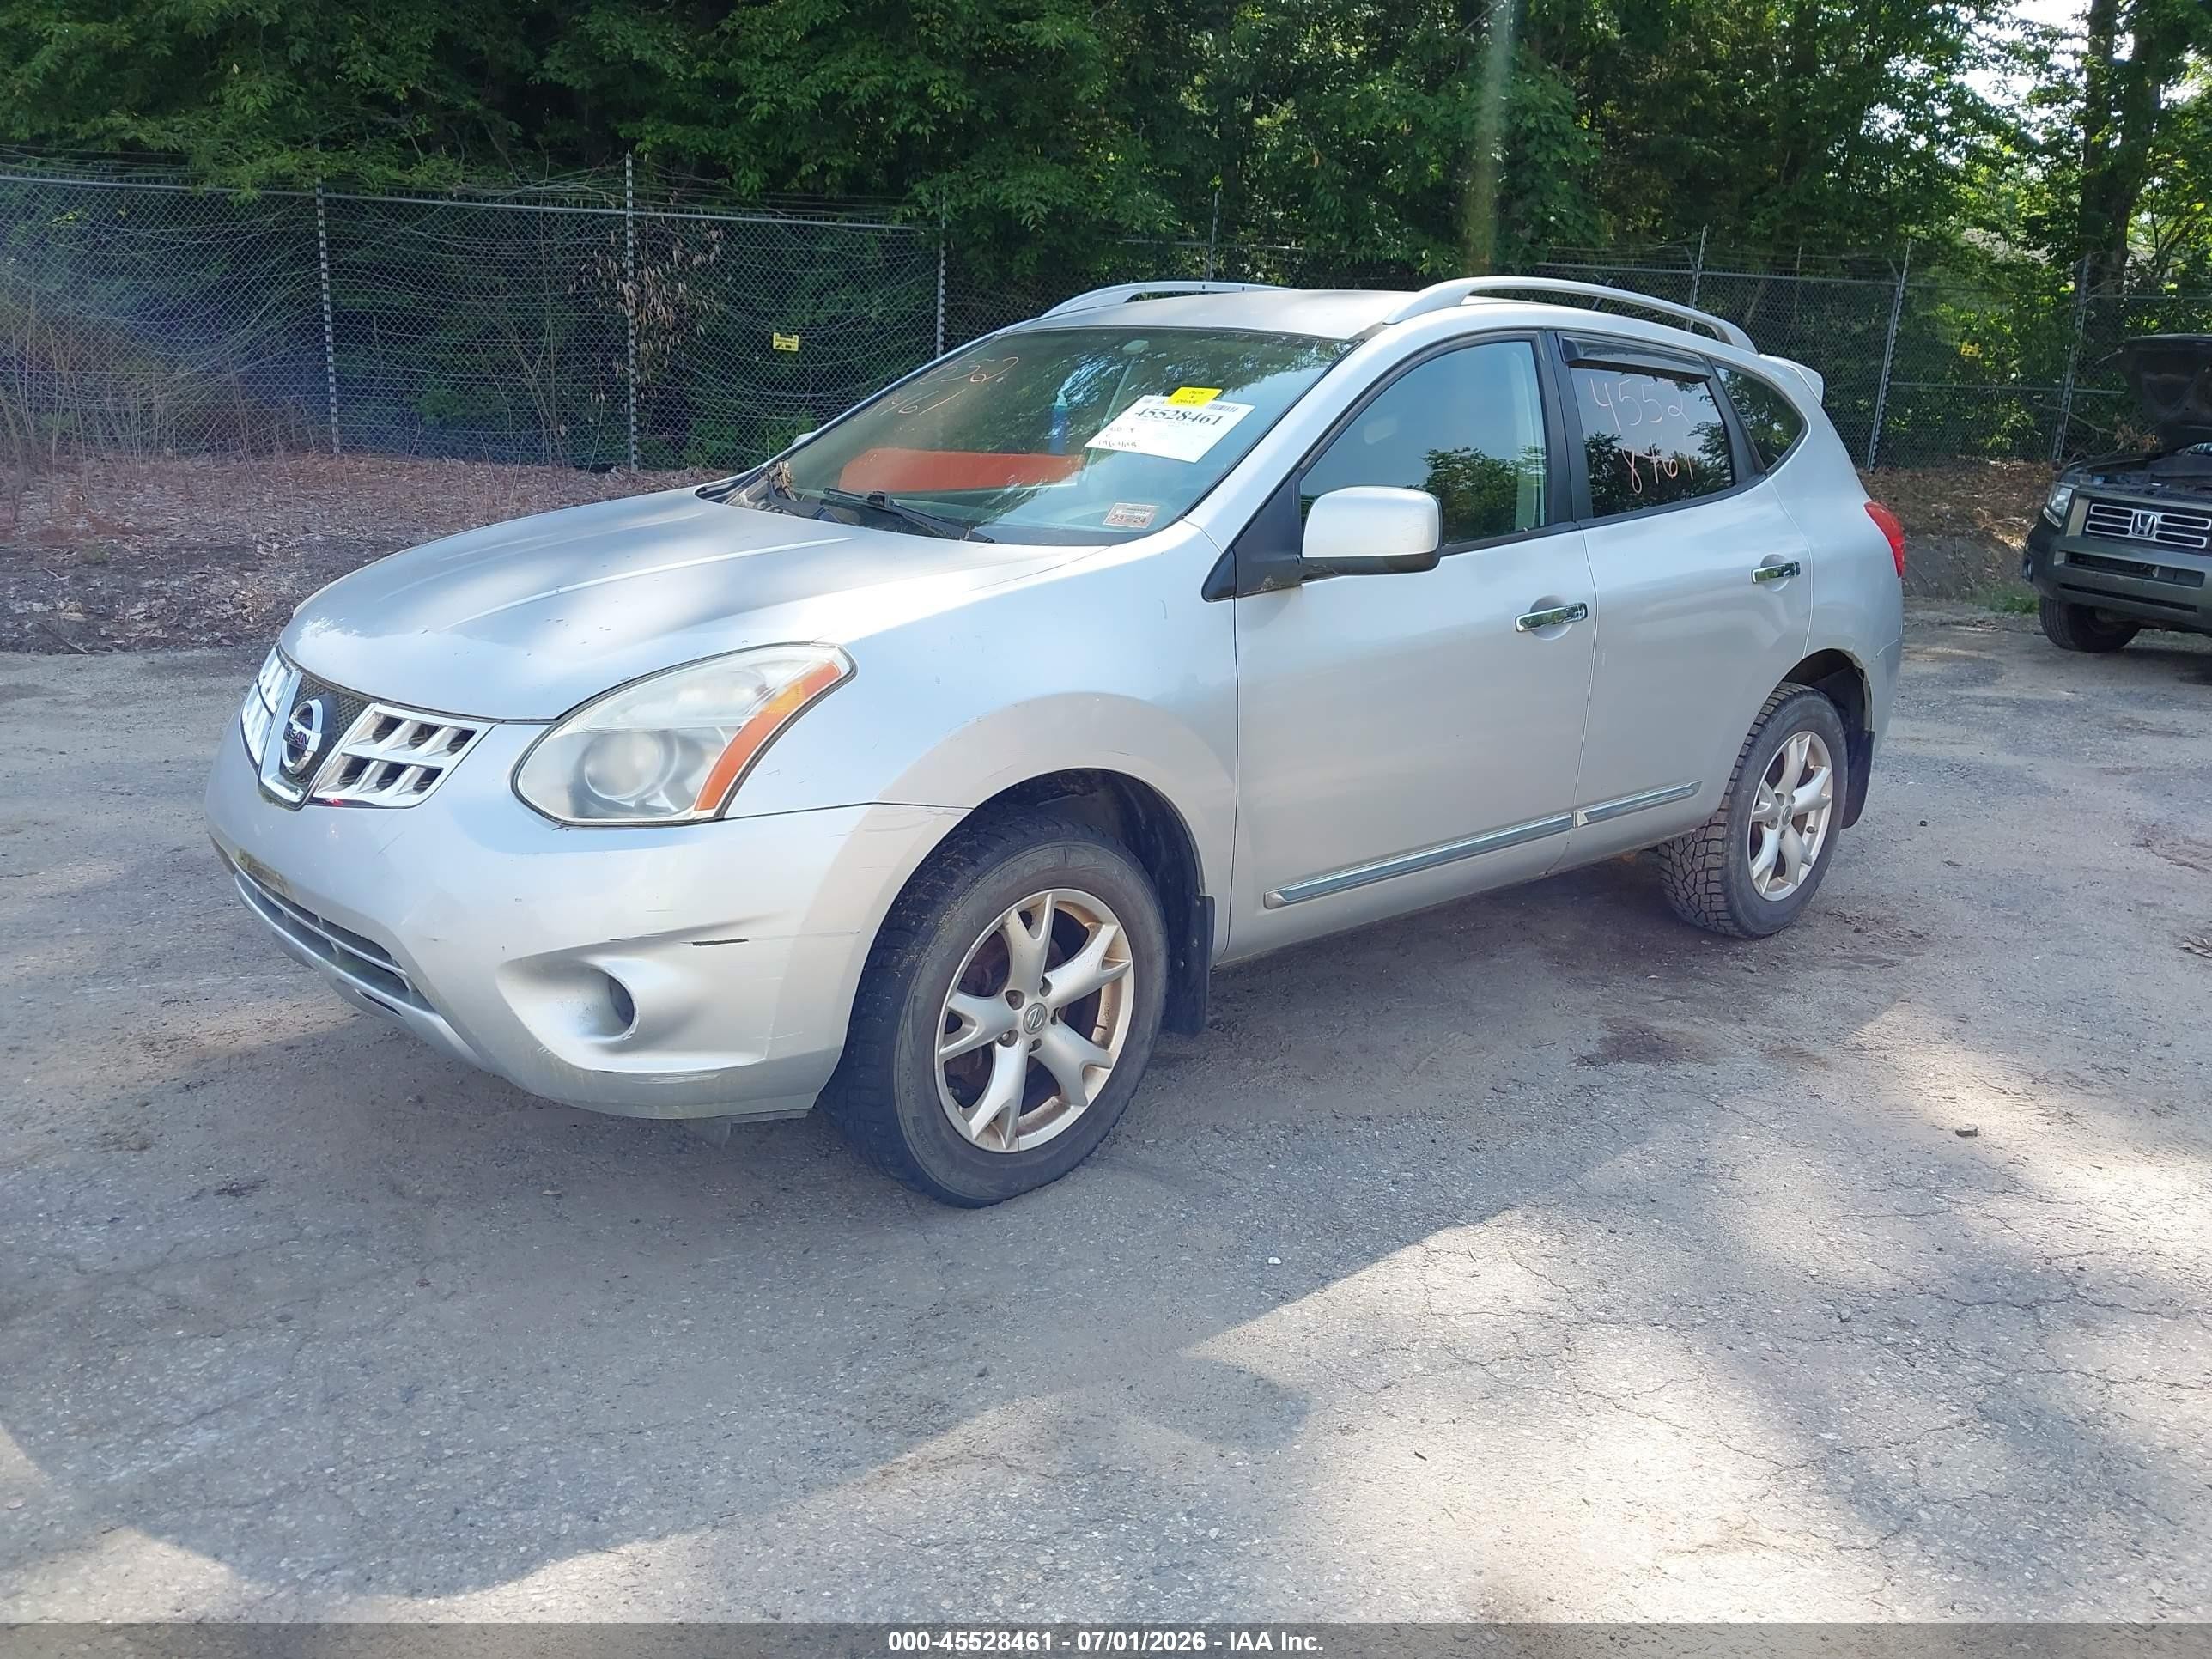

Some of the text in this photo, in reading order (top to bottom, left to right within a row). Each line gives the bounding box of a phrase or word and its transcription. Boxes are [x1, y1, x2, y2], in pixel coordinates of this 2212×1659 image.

[1134, 407, 1224, 426] 45528461
[1589, 377, 1690, 432] 4552
[1621, 438, 1694, 495] 8461
[283, 727, 311, 746] ISSAN
